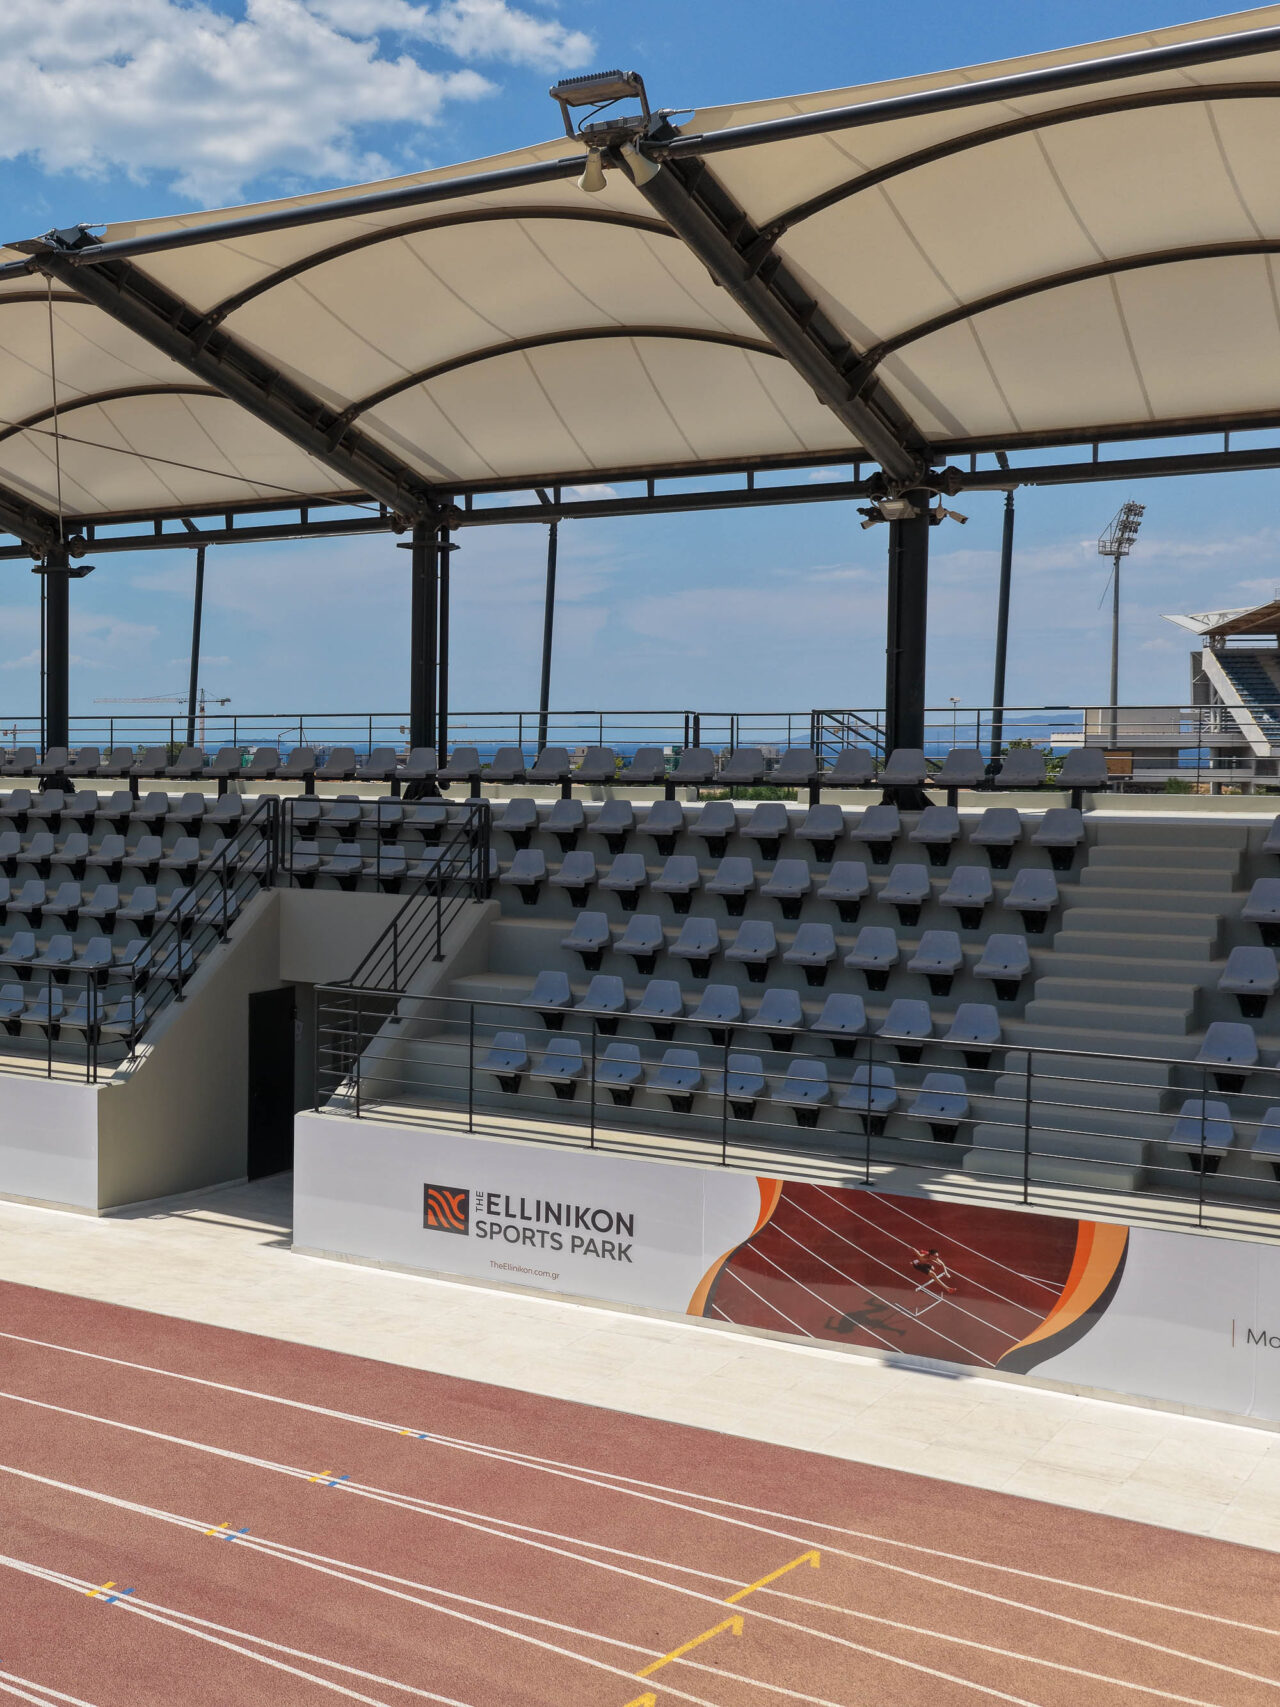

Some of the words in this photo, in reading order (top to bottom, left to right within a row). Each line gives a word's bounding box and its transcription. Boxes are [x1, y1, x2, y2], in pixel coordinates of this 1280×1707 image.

[475, 1190, 484, 1213] THE
[486, 1192, 635, 1238] ELLINIKON
[475, 1220, 563, 1251] SPORTS
[571, 1235, 634, 1264] PARK
[489, 1260, 561, 1281] TheEllinikon.com.gr
